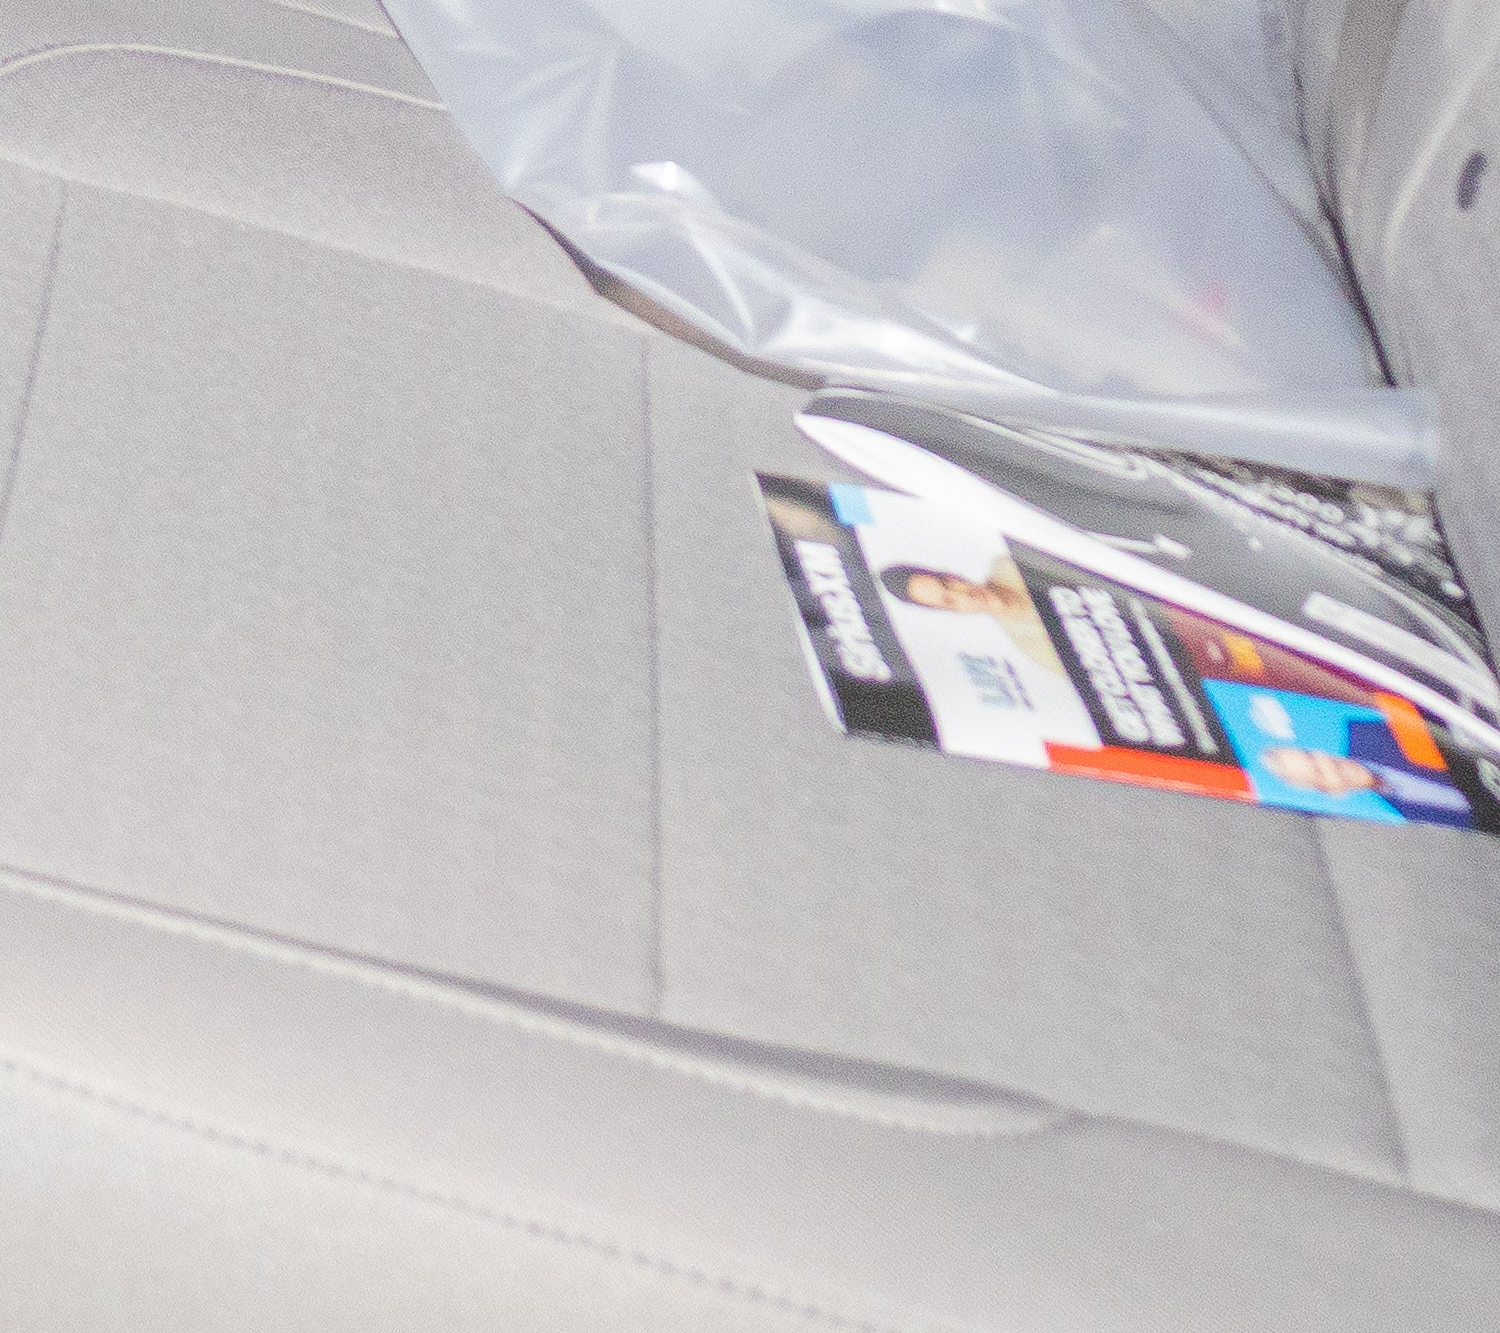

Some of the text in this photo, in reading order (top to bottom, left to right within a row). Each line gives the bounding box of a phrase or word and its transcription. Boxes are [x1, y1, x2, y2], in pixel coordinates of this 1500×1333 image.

[793, 539, 893, 681] SiriusXM
[1048, 585, 1091, 618] TO
[1063, 616, 1129, 696] CLOSER
